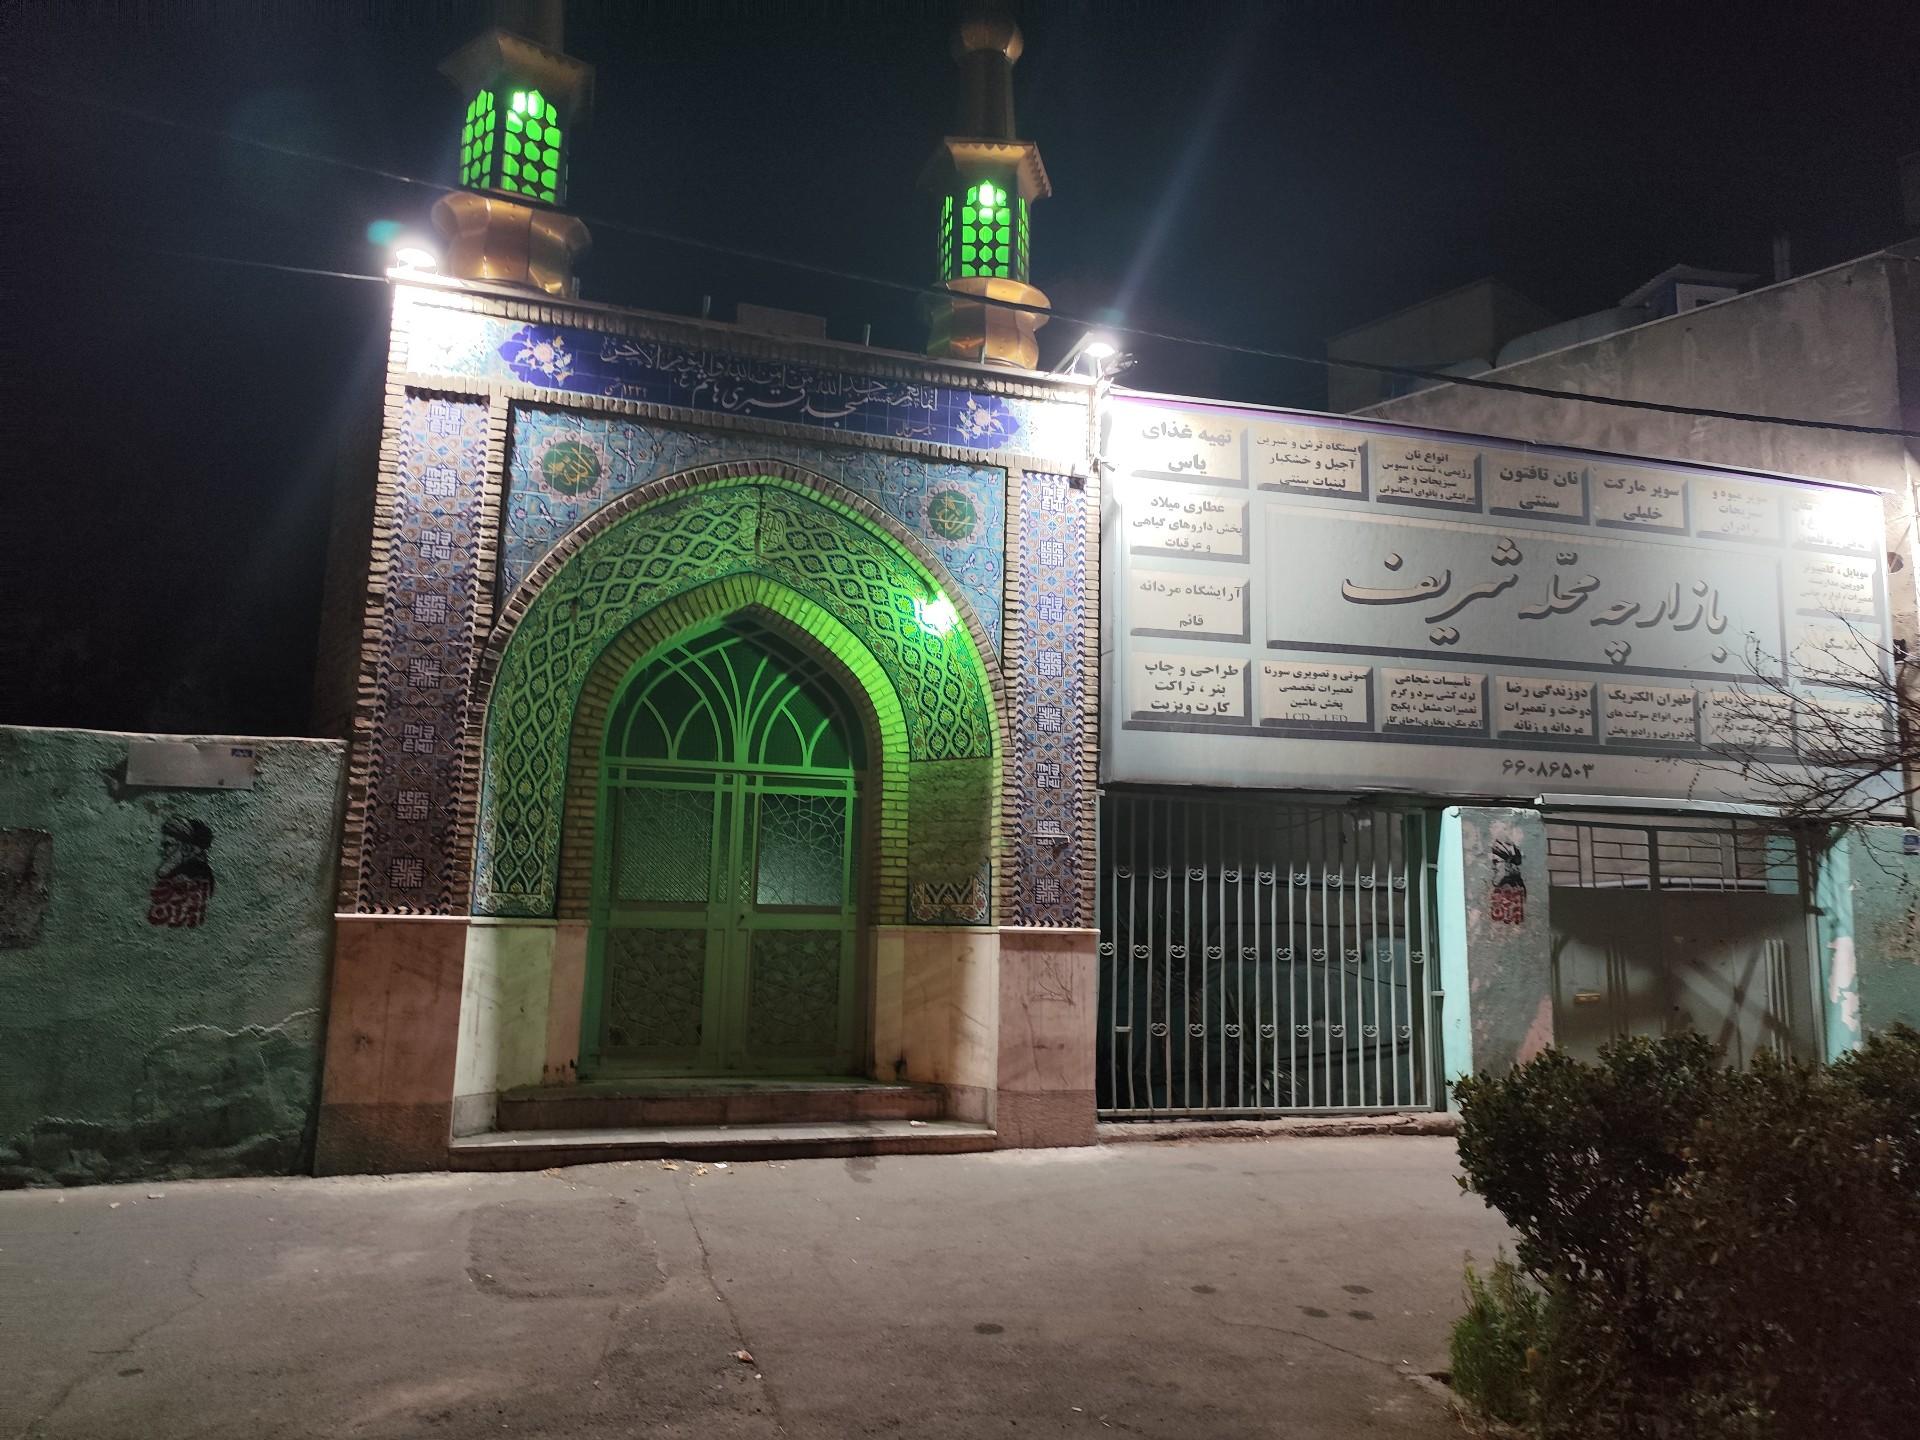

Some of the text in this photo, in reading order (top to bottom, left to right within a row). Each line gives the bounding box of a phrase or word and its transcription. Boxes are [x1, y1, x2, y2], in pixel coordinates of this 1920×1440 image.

[1142, 420, 1232, 447] تهیه غذای
[1292, 441, 1297, 449] و
[1300, 439, 1323, 452] ترش
[1269, 453, 1356, 472] آجیل و خشکبار
[1405, 449, 1449, 463] انواع نان
[1168, 454, 1208, 475] یاس
[1398, 474, 1409, 484] جو
[1443, 469, 1472, 479] رژیمی
[1500, 465, 1578, 487] نان تافتون
[1280, 474, 1346, 491] لبنیات سنتی
[1603, 478, 1680, 498] سوپر مارکت
[1150, 496, 1224, 514] عطاری میلاد
[1519, 495, 1559, 509] سنتی
[1623, 506, 1663, 522] خلیلی
[1132, 516, 1166, 528] گیاهی
[1168, 519, 1213, 533] داروهای
[1165, 538, 1211, 553] و عرقیات
[1139, 579, 1243, 602] آرایشگاه مردانه
[1341, 537, 1522, 646] شریف
[1590, 578, 1728, 668] بازارچه
[1145, 660, 1239, 679] طراحی و چاپ
[1264, 665, 1290, 677] سورنا
[1292, 669, 1330, 679] تصویری
[1340, 671, 1367, 681] صوتی
[1394, 674, 1430, 686] شجاعی
[1155, 680, 1196, 695] تراکت
[1208, 684, 1226, 697] بنر
[1279, 683, 1353, 695] تعمیرات تخصصی
[1506, 681, 1588, 700] دوزندگی رضا
[1390, 688, 1477, 703] لوله کشی سرد و گرم
[1608, 690, 1653, 704] الکتریک
[1151, 700, 1230, 715] کارت ویزیت
[1290, 698, 1344, 709] پخش ماشین
[1390, 702, 1410, 713] پکیج
[1419, 703, 1442, 713] مشعل
[1444, 705, 1477, 716] تعمیرات
[1504, 702, 1592, 718] دوخت و تعمیرات
[1606, 709, 1623, 719] های
[1625, 710, 1649, 720] سوکت
[1651, 712, 1671, 722] انواع
[1513, 720, 1538, 732] زنانه
[1550, 722, 1584, 735] مردانه
[1502, 759, 1595, 779] ۶۶۰۸۶۵۰۳
